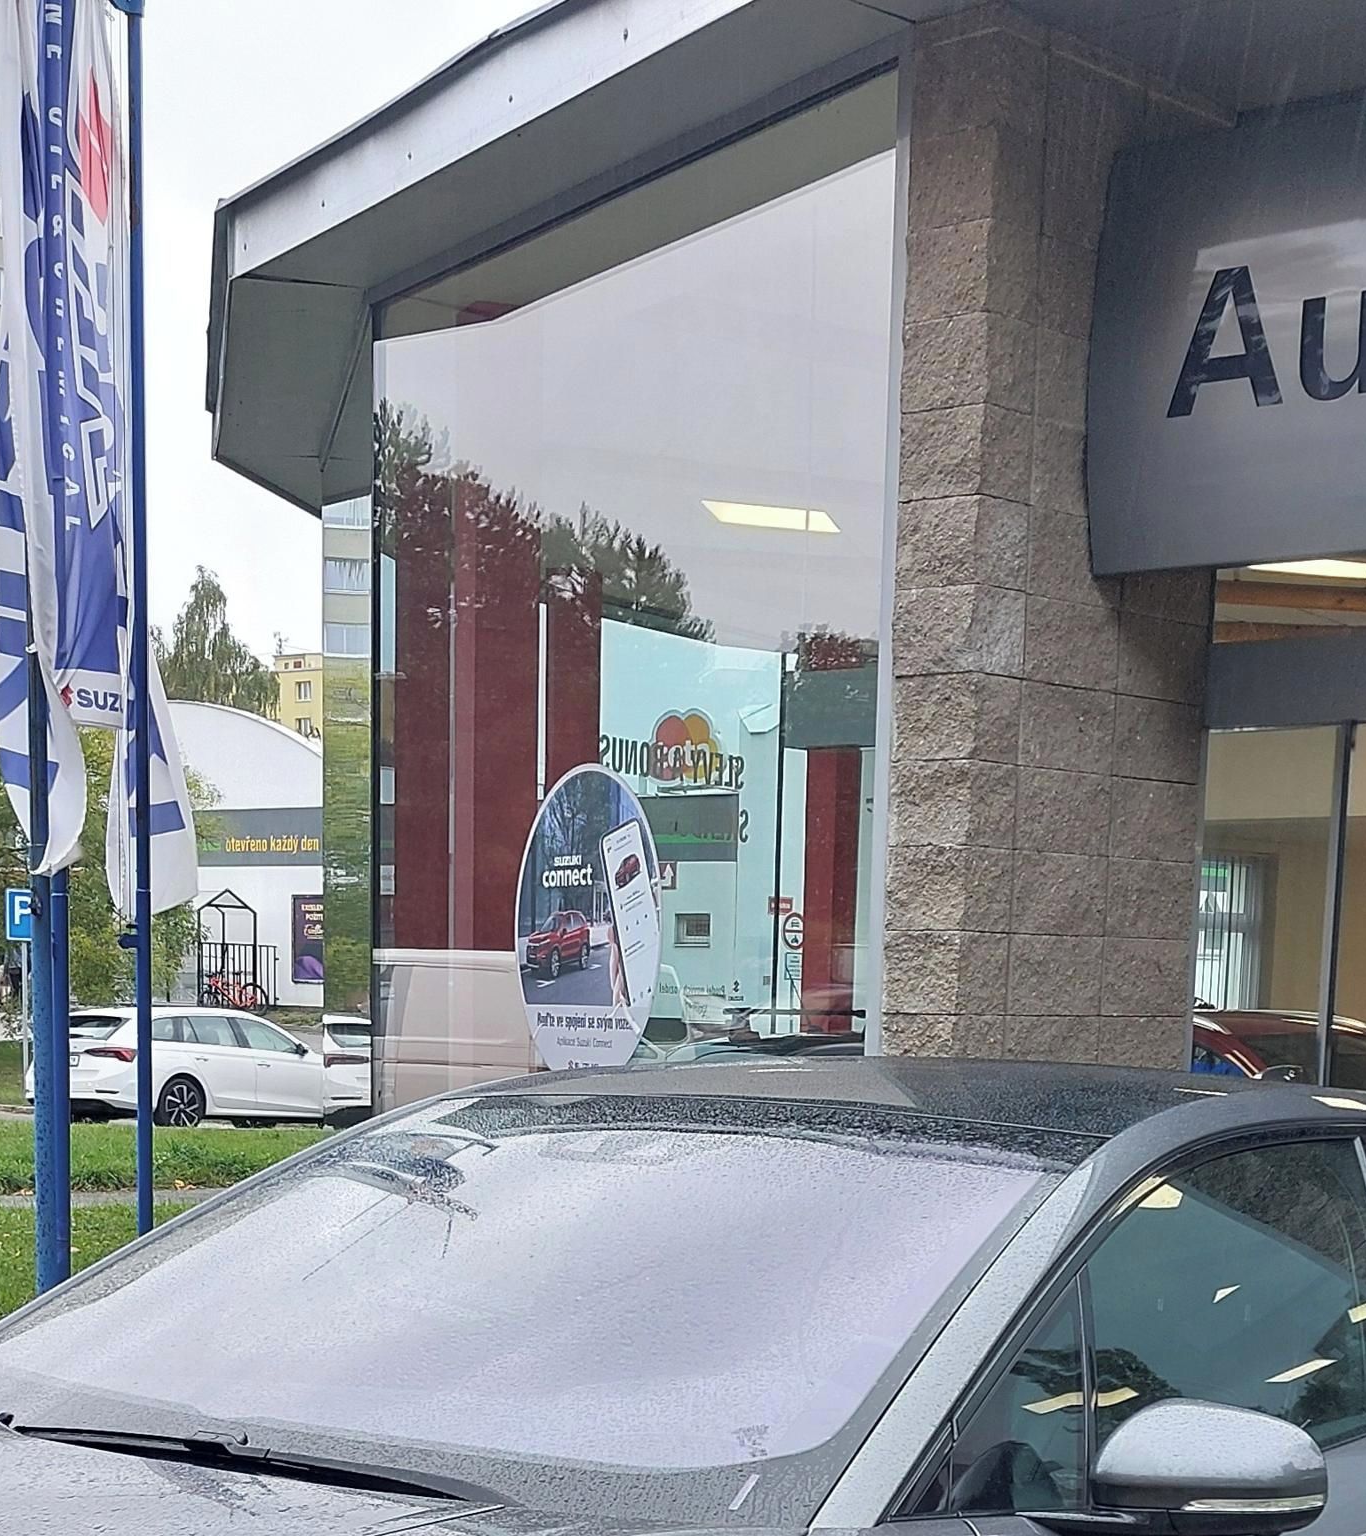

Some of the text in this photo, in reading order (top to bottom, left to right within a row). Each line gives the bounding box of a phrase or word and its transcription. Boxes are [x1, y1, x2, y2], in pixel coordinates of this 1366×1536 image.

[225, 835, 268, 853] otevřeno
[270, 834, 299, 855] každý
[300, 834, 319, 852] den
[553, 854, 582, 867] SUZUKI
[542, 863, 593, 889] connect
[13, 895, 32, 926] P
[615, 1016, 633, 1031] voze
